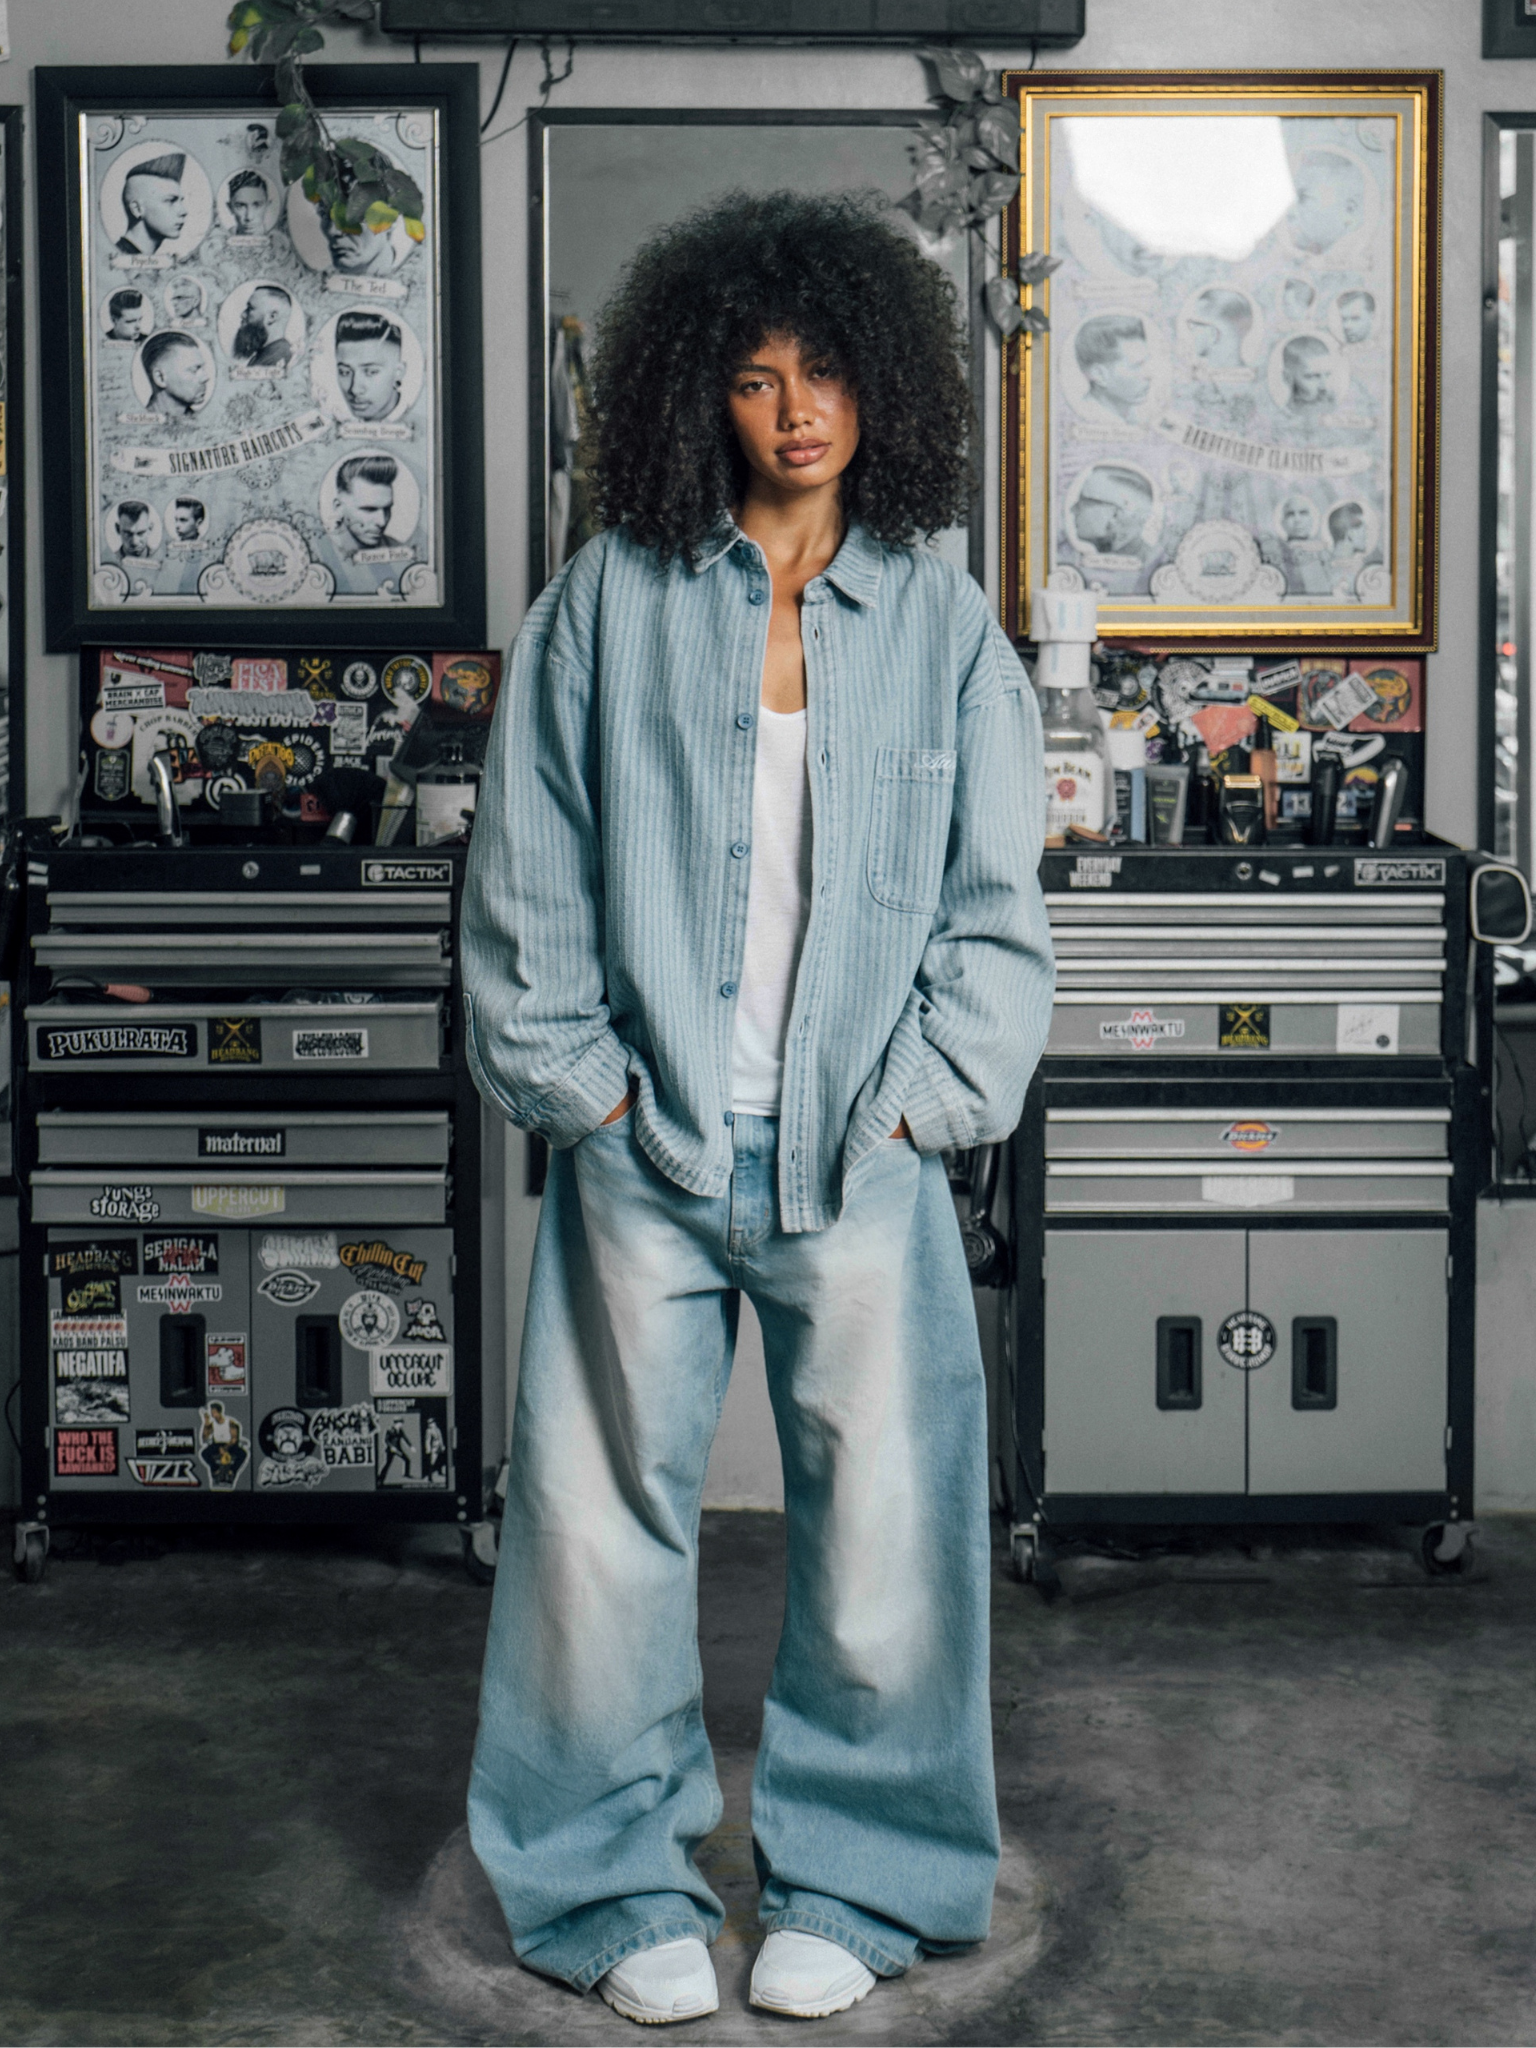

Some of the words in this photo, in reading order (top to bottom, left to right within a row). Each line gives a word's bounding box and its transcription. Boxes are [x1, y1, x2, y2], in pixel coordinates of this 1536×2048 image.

[341, 278, 363, 292] The
[366, 280, 388, 294] Ted
[168, 444, 240, 474] SIGNATURE
[242, 420, 304, 461] HAIRCUTS
[1267, 448, 1325, 473] CLASSICS
[105, 696, 164, 707] MERCHANDISE
[384, 865, 444, 881] TACTIX
[1069, 872, 1113, 887] WEEKEND
[50, 1028, 188, 1057] PUKULRATA
[195, 1184, 282, 1209] UPPERCUT
[144, 1238, 218, 1261] SERIGALA
[340, 1243, 394, 1267] Chillin
[55, 1249, 132, 1271] HEADBANG
[53, 1337, 74, 1347] KAOS
[76, 1337, 98, 1346] BAND
[57, 1350, 127, 1377] NEGATIFA
[58, 1431, 89, 1445] WHO
[91, 1430, 114, 1444] THE
[57, 1446, 97, 1463] FUCK
[99, 1445, 116, 1462] IS
[324, 1446, 374, 1465] BABI
